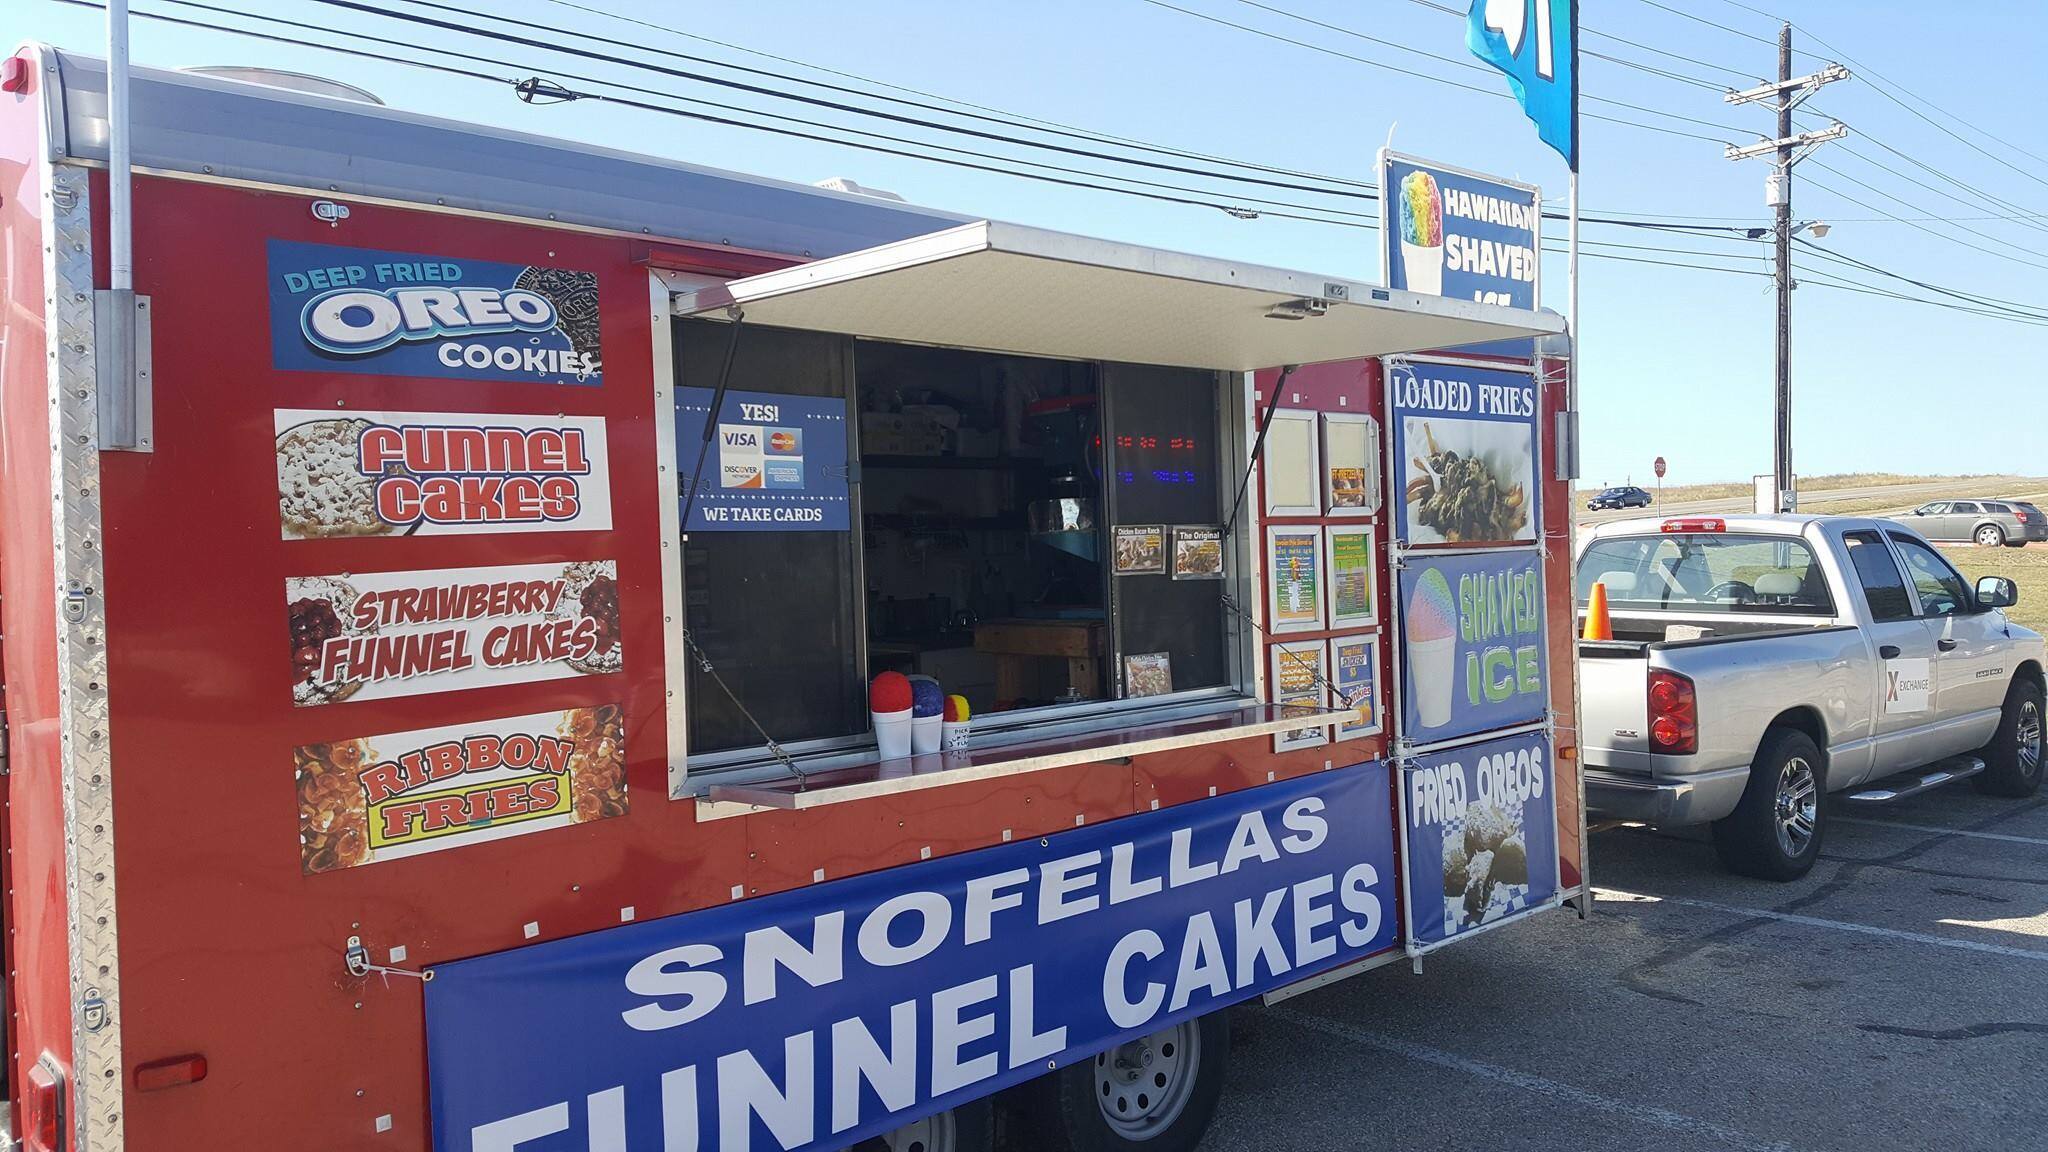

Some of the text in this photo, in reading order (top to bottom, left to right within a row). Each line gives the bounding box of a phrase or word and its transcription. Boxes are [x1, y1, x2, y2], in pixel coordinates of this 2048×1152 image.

[1443, 187, 1535, 232] HAWAIIAN
[284, 263, 462, 293] DEEP FRIED
[1446, 233, 1536, 282] SHAVED
[310, 289, 553, 344] OREO
[438, 343, 595, 374] COOKIES
[740, 403, 780, 422] YES!
[1393, 376, 1534, 417] LOADED FRIES
[722, 432, 757, 446] VISA
[702, 507, 823, 522] WE TAKE CARDS
[1194, 531, 1220, 540] Original
[353, 579, 567, 630] STRAWBERRY
[1459, 567, 1539, 642] SHAVED
[320, 617, 599, 684] FUNNEL CAKES
[1465, 645, 1541, 706] ICE
[1900, 680, 1929, 692] EXCHANGE
[360, 735, 575, 804] RIBBON
[1411, 746, 1544, 828] FRIED OREOS
[381, 779, 560, 839] FRIES
[621, 797, 1328, 1032] SNOFELLAS
[1103, 863, 1382, 1029] CAKES
